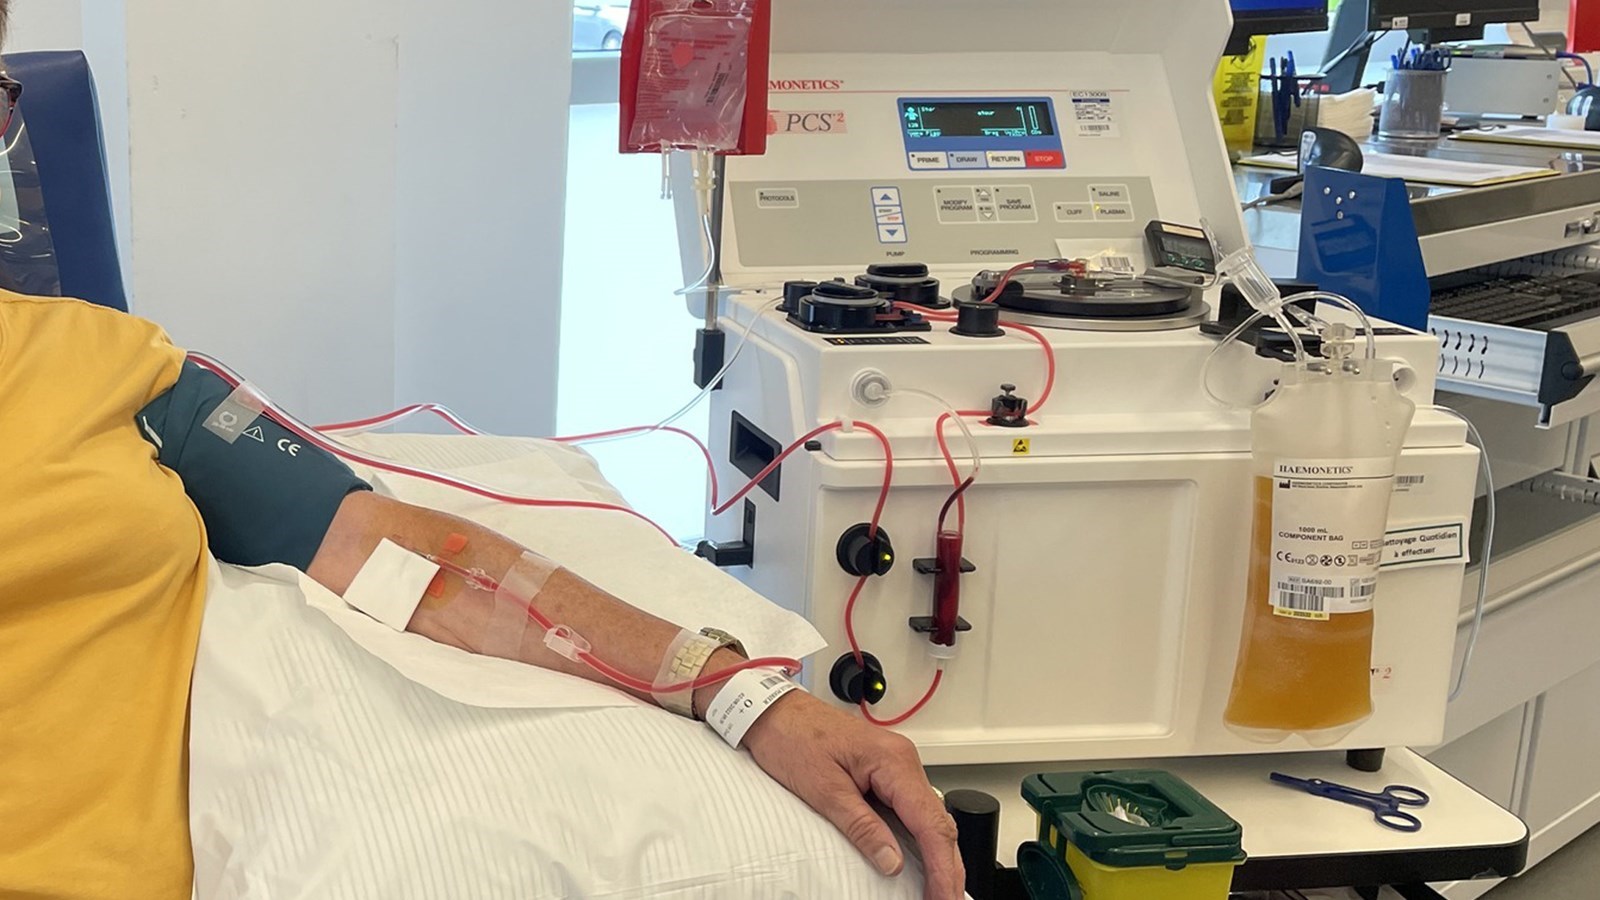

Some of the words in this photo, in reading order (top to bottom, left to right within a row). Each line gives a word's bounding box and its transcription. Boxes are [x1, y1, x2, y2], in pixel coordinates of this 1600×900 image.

[767, 80, 840, 90] MONETICS
[785, 113, 832, 132] PCS
[991, 155, 1020, 163] RETURN
[1279, 464, 1352, 475] HAEMONETICS
[1278, 531, 1327, 541] COMPONENT
[1419, 531, 1457, 542] Quotidien
[1401, 547, 1436, 557] effectuer
[1383, 667, 1392, 679] 2
